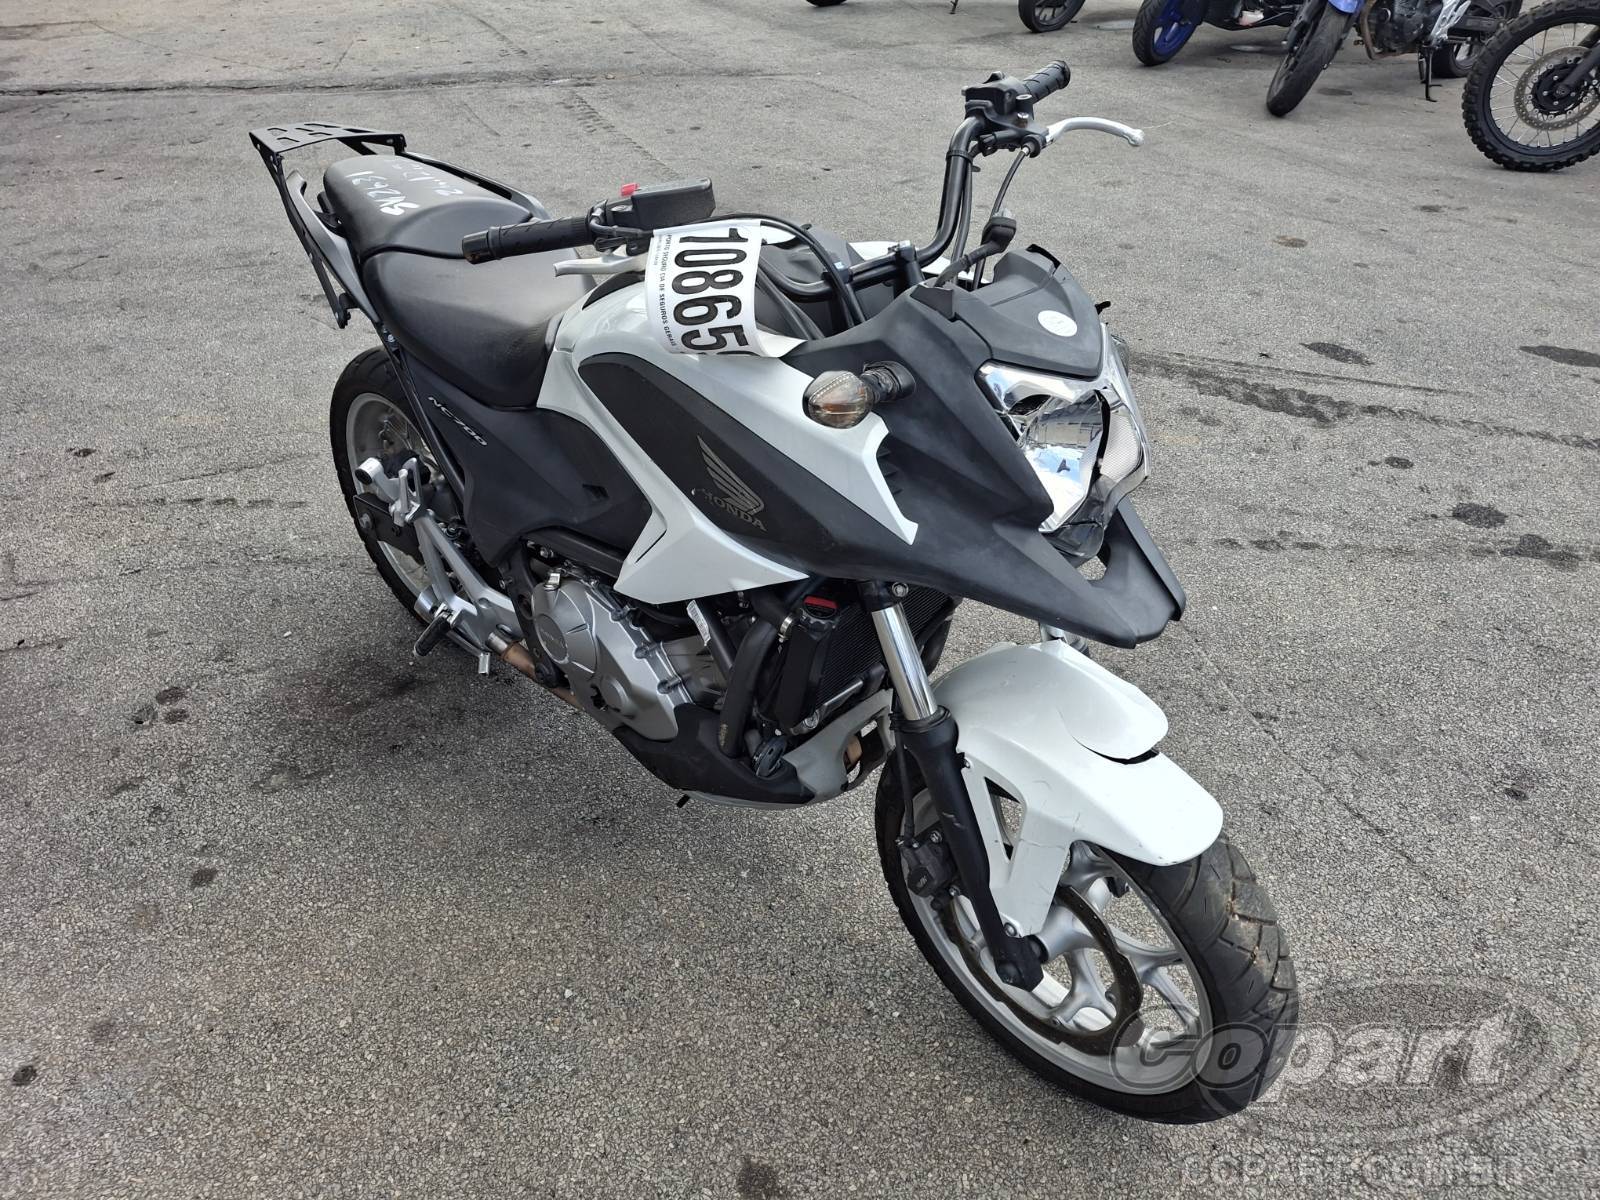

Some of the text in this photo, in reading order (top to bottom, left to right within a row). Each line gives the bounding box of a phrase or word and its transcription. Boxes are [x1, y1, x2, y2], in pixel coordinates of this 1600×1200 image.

[664, 234, 672, 250] PORTO
[659, 293, 668, 324] SEGUROS
[672, 228, 754, 354] 10865
[427, 396, 488, 446] NC700
[703, 492, 768, 532] HONDA
